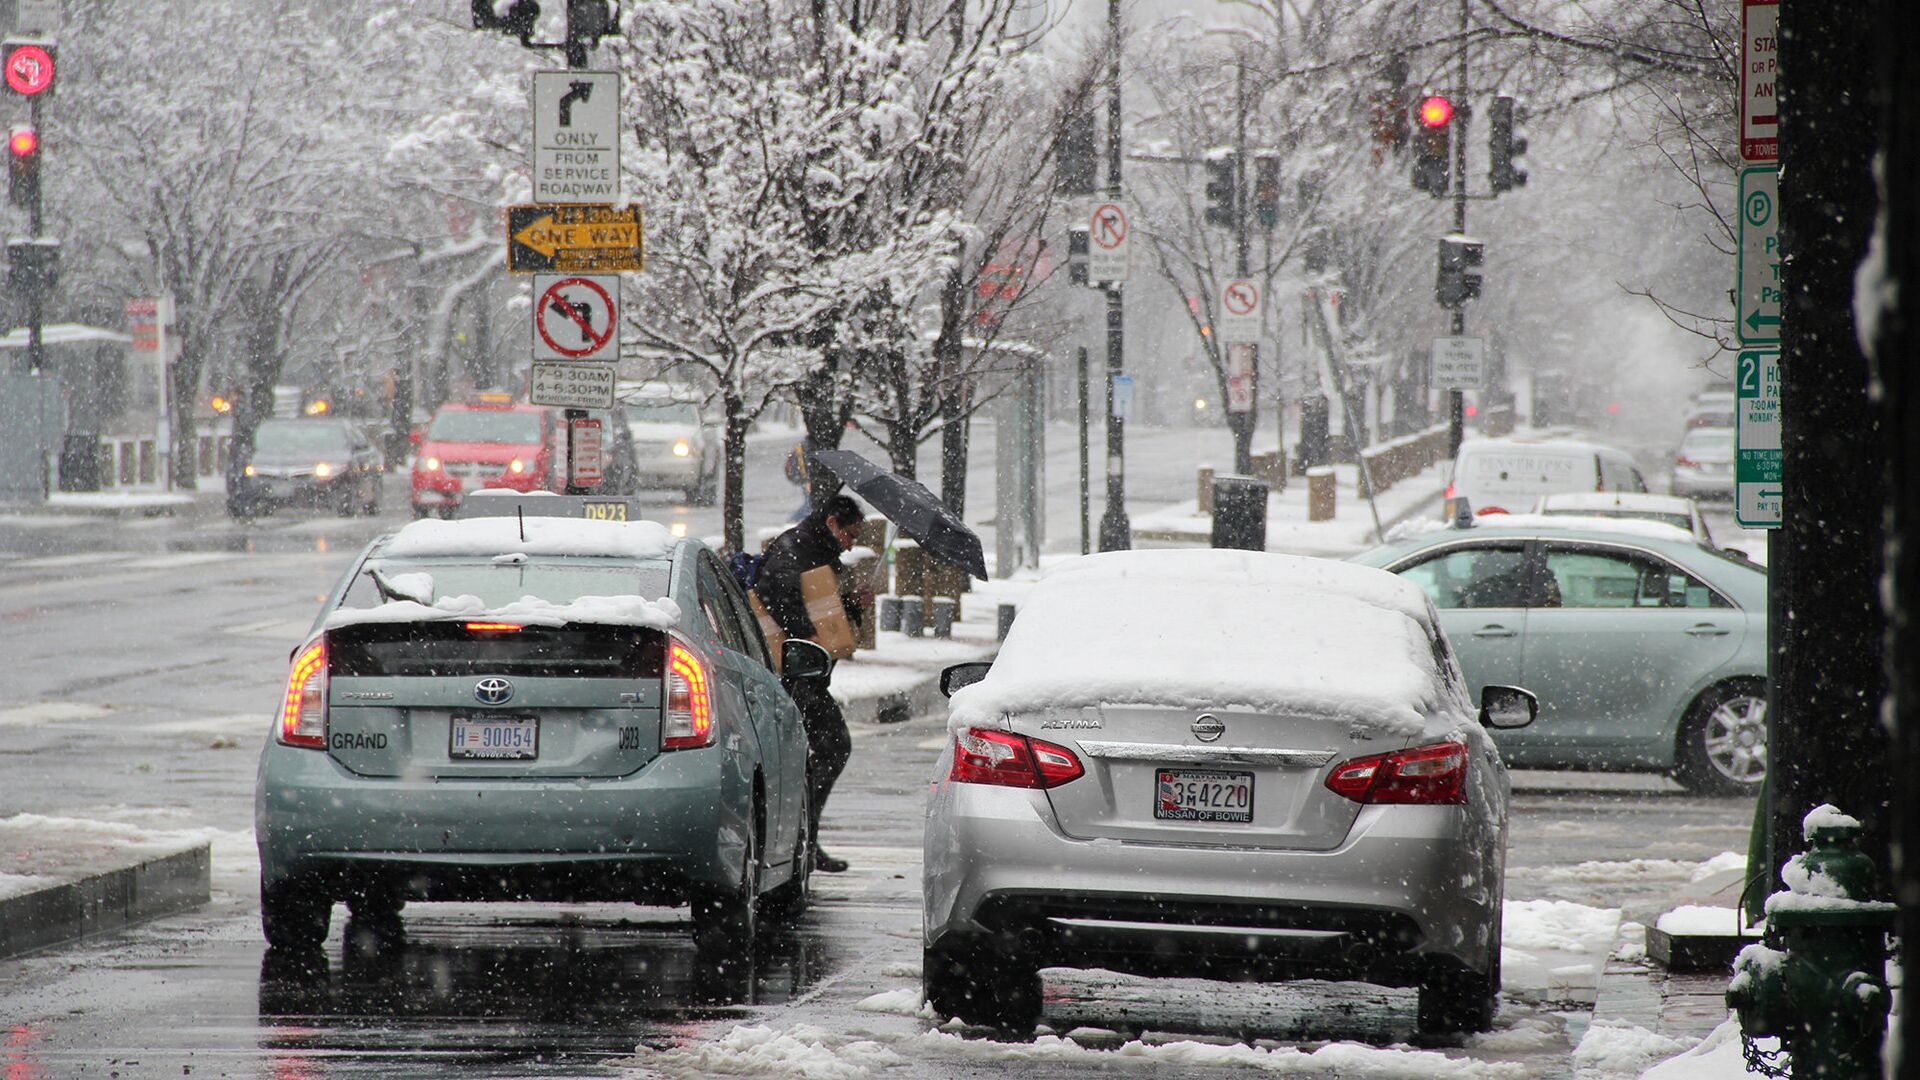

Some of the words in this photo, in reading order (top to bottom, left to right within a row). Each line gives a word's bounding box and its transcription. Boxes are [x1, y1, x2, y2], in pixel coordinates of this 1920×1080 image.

[1752, 62, 1765, 74] OR
[1768, 60, 1777, 73] P
[554, 132, 599, 146] ONLY
[555, 153, 599, 165] FROM
[544, 168, 609, 180] SERVICE
[540, 183, 613, 195] ROADWAY
[530, 228, 577, 246] ONE
[590, 227, 633, 244] WAY
[536, 368, 610, 382] 7-9:30AM
[1741, 358, 1756, 390] 2
[1742, 451, 1752, 460] NO
[1754, 451, 1768, 460] TIME
[585, 502, 627, 522] D923
[1757, 502, 1770, 511] PAY
[1771, 502, 1780, 511] TO
[341, 691, 395, 700] PRIUS
[1040, 719, 1102, 729] ALTIMA
[332, 733, 388, 750] GRAND
[455, 726, 466, 747] H
[483, 726, 532, 748] 90054
[618, 726, 640, 750] D923
[1182, 773, 1228, 781] MARYLAND
[1157, 809, 1196, 819] NISSAN
[1198, 811, 1213, 820] OF
[1215, 812, 1250, 821] BOWIE
